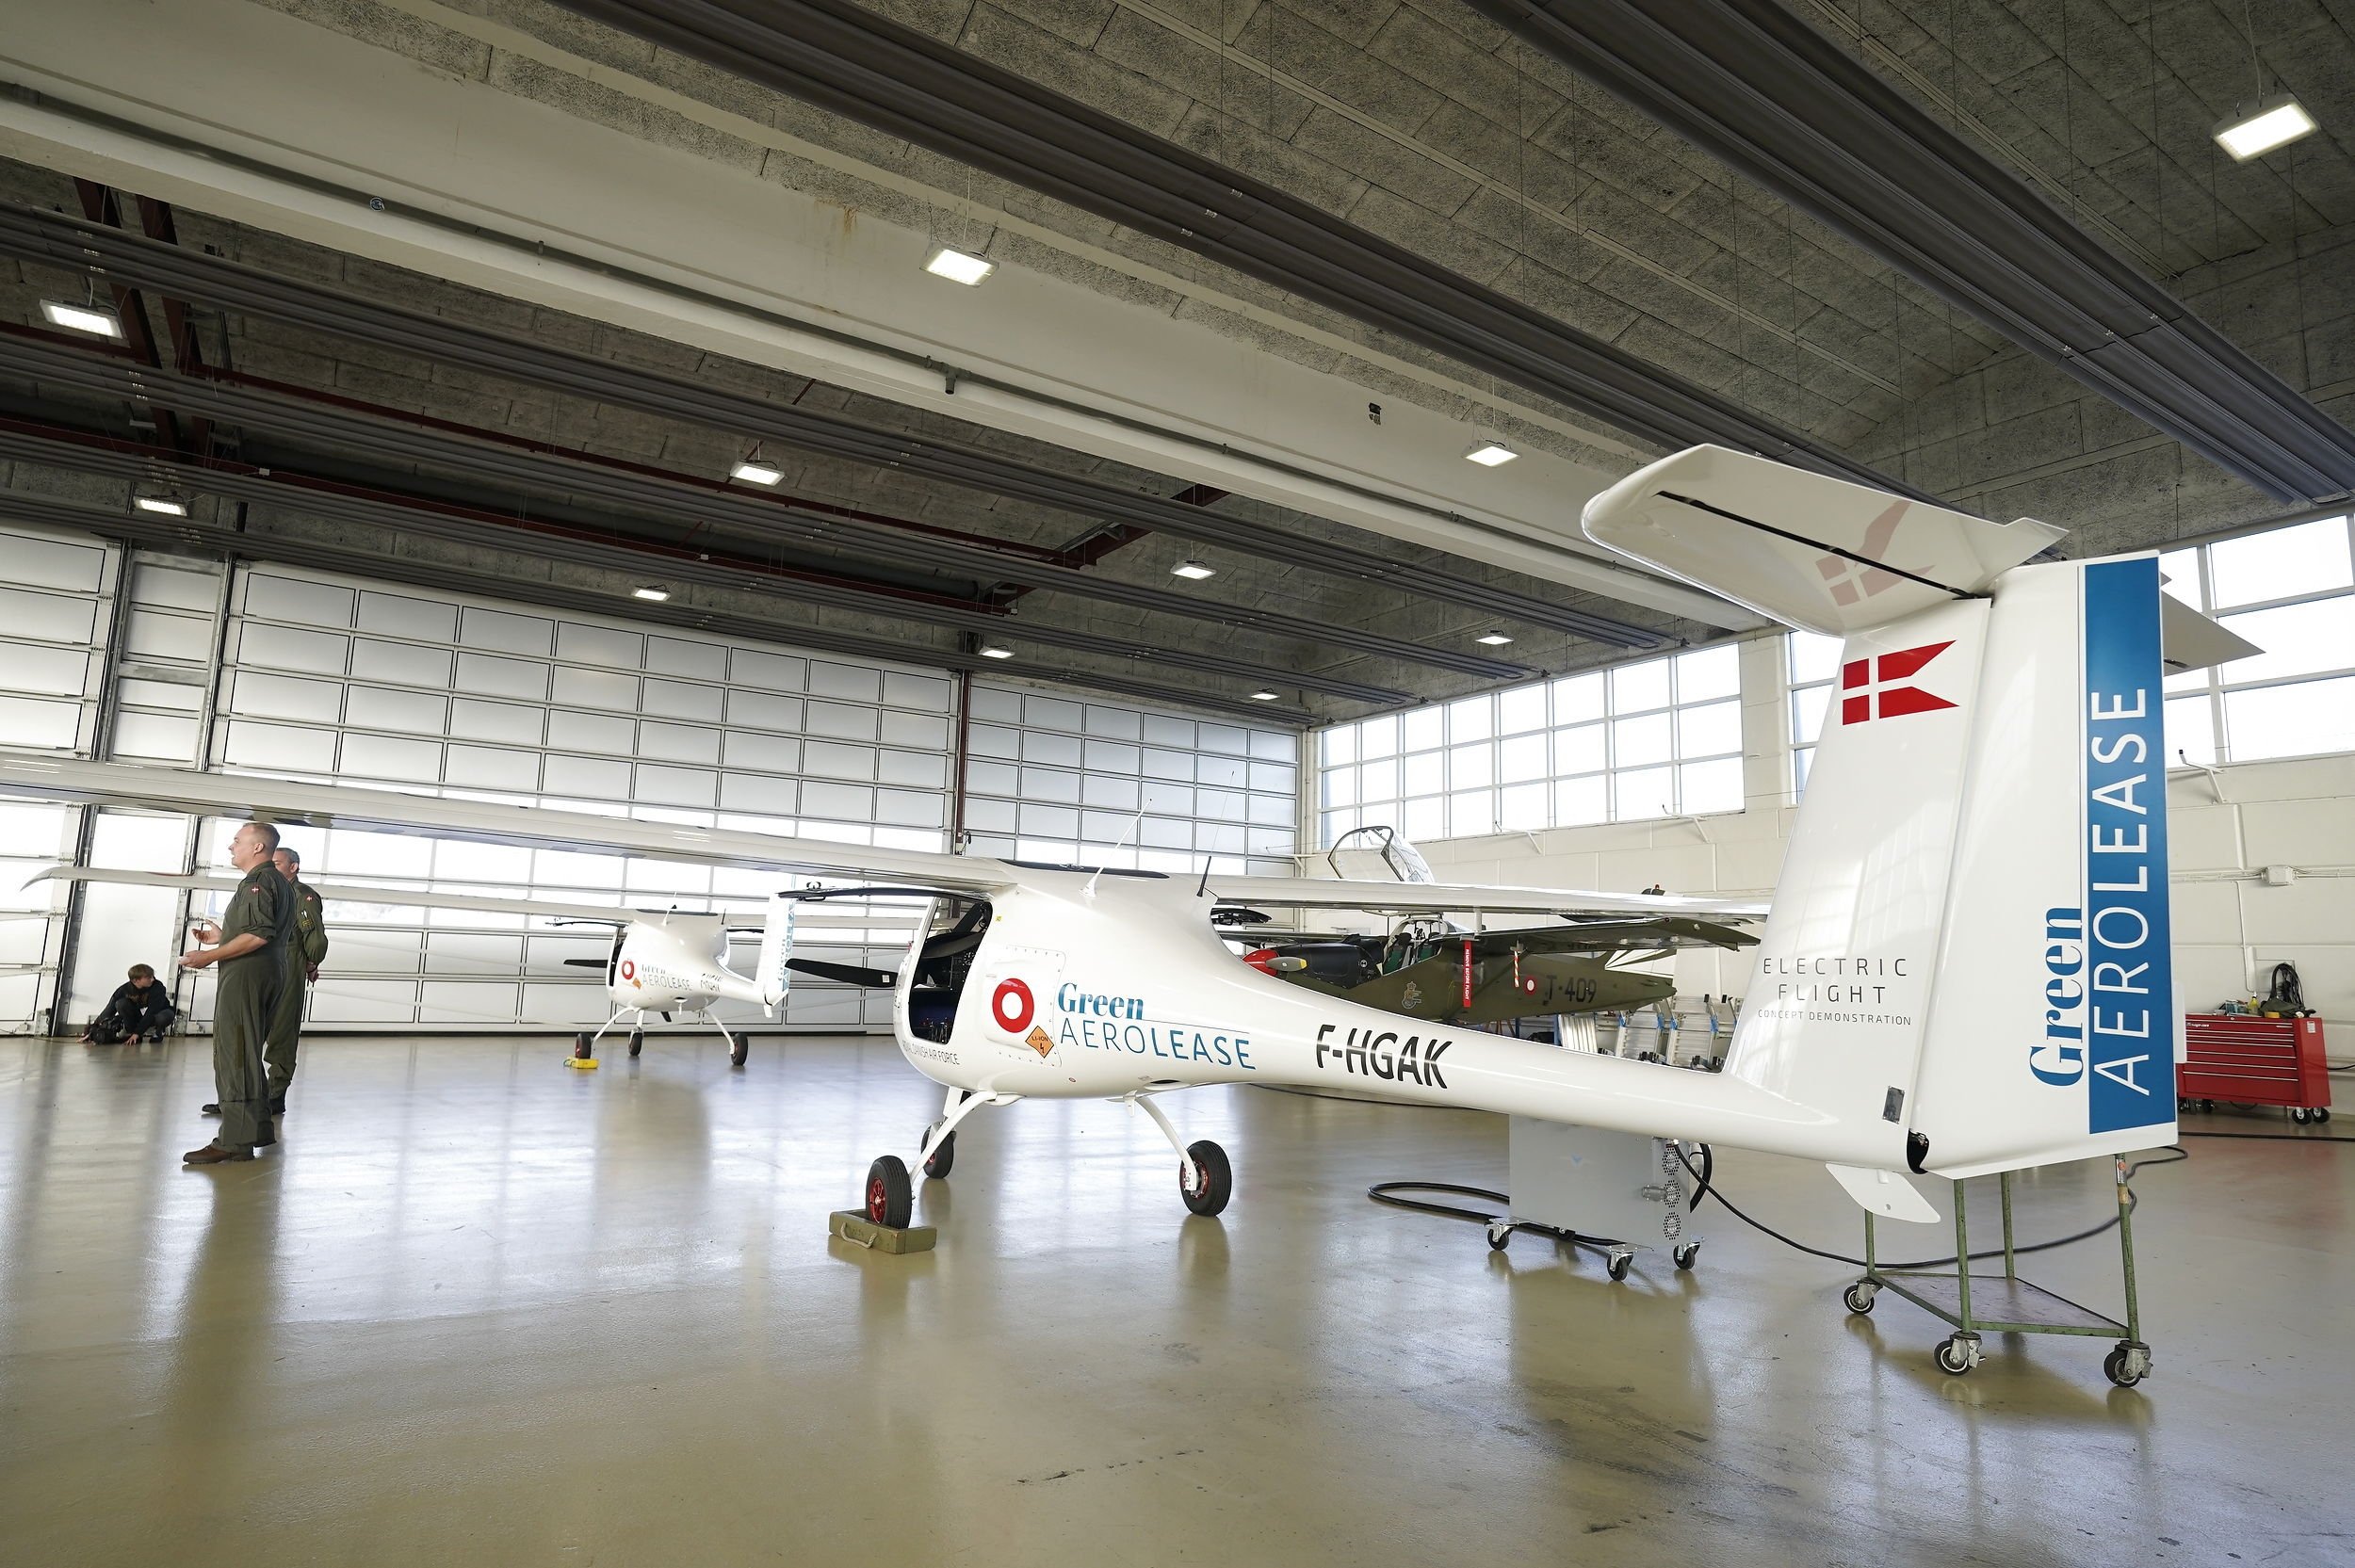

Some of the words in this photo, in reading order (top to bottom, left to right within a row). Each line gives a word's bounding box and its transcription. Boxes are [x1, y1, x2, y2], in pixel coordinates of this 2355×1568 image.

[2090, 688, 2151, 1097] AEROLEASE
[1763, 958, 1907, 977] ELECTRIC
[1057, 981, 1145, 1021] Green
[1778, 983, 1886, 1004] FLIGHT
[2029, 907, 2084, 1089] Green
[1758, 1009, 1804, 1021] CONCEPT
[1809, 1011, 1911, 1026] DEMONSTRATION
[937, 1050, 961, 1065] FORCE
[1060, 1017, 1257, 1071] AEROLEASE
[1316, 1024, 1454, 1090] F-HGAK
